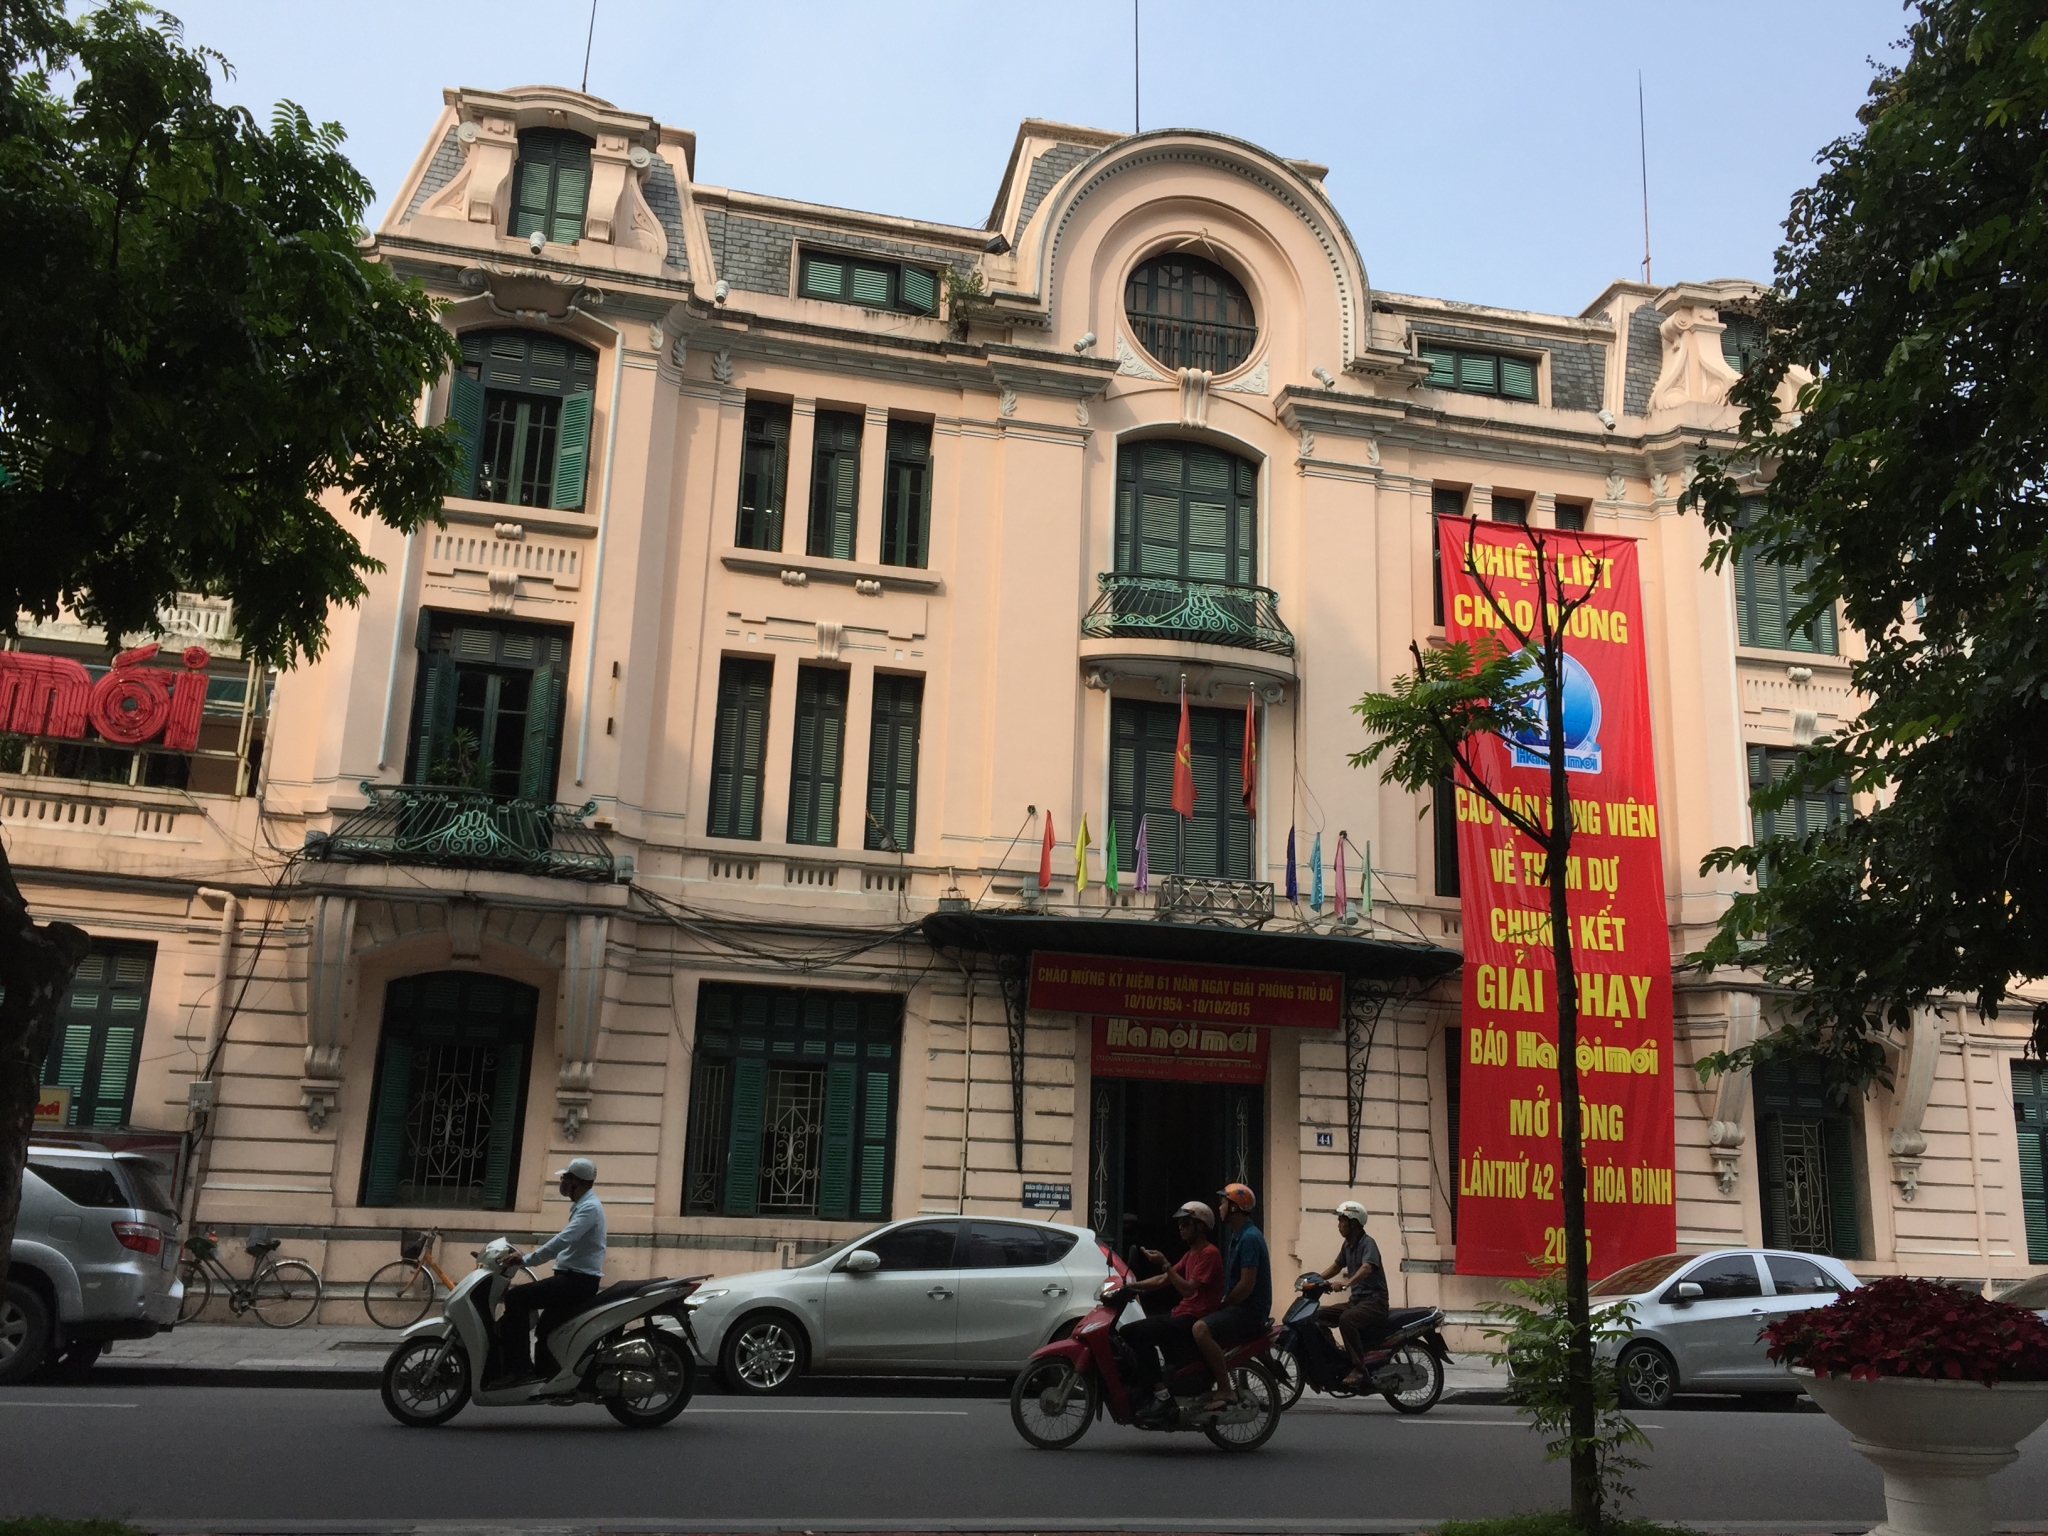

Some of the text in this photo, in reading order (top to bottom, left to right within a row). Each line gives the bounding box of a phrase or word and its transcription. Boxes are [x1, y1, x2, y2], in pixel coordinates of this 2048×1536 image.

[1464, 542, 1613, 593] NHIỆT LIỆT
[1454, 591, 1534, 632] CHÀO
[1456, 783, 1656, 838] CÁC VẬN NG VIÊN
[1490, 838, 1620, 900] VỀ THM DỰ
[1580, 905, 1626, 952] KẾT
[1038, 965, 1068, 983] CHÀO
[1109, 968, 1124, 988] KỶ
[1126, 971, 1155, 991] NIỆM
[1157, 975, 1169, 991] 61
[1173, 974, 1198, 993] NĂM
[1201, 977, 1231, 996] NGÀY
[1233, 976, 1254, 997] GIẢI
[1258, 981, 1294, 999] PHÓNG
[1297, 982, 1317, 1001] THỦ
[1319, 985, 1334, 1002] ĐÔ
[1124, 994, 1183, 1012] 10/10/1954
[1192, 999, 1251, 1017] 10/10/2015
[1477, 949, 1652, 1028] GIẢI HẠY
[1470, 1021, 1659, 1077] BÁO Hàộimới
[1318, 1134, 1331, 1145] 44
[1509, 1084, 1624, 1148] MỞ ỘNG
[1532, 1163, 1554, 1201] 42
[1593, 1157, 1627, 1204] HÒA
[1631, 1159, 1673, 1206] BÌNH
[1544, 1226, 1592, 1265] 205
